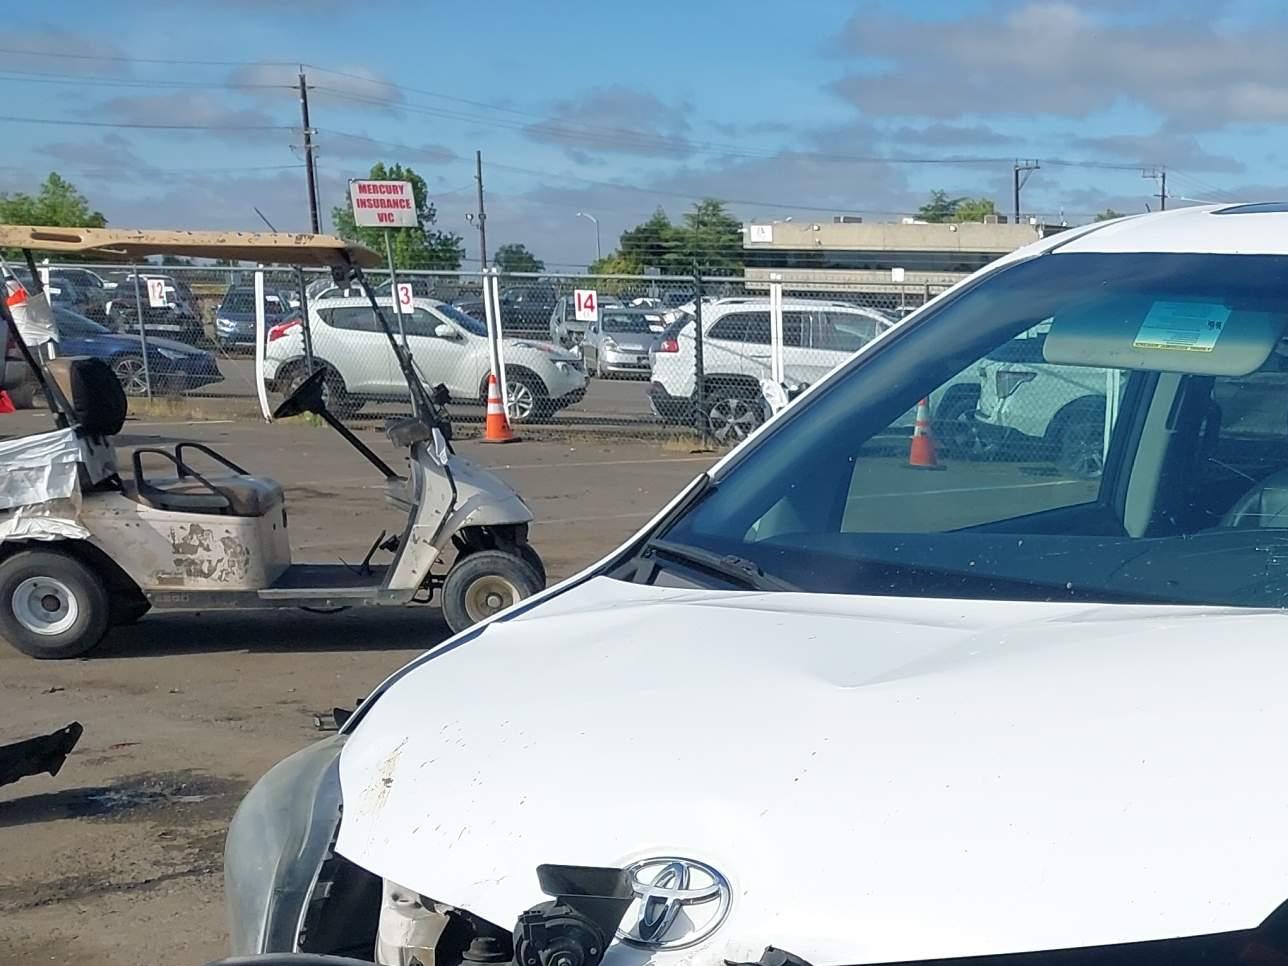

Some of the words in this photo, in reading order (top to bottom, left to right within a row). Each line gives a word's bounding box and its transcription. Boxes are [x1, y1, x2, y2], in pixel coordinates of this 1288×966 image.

[358, 184, 404, 194] MERCURY
[357, 199, 411, 208] INSURANCE
[377, 212, 395, 222] VIC
[399, 286, 410, 304] 3
[577, 293, 595, 312] 14
